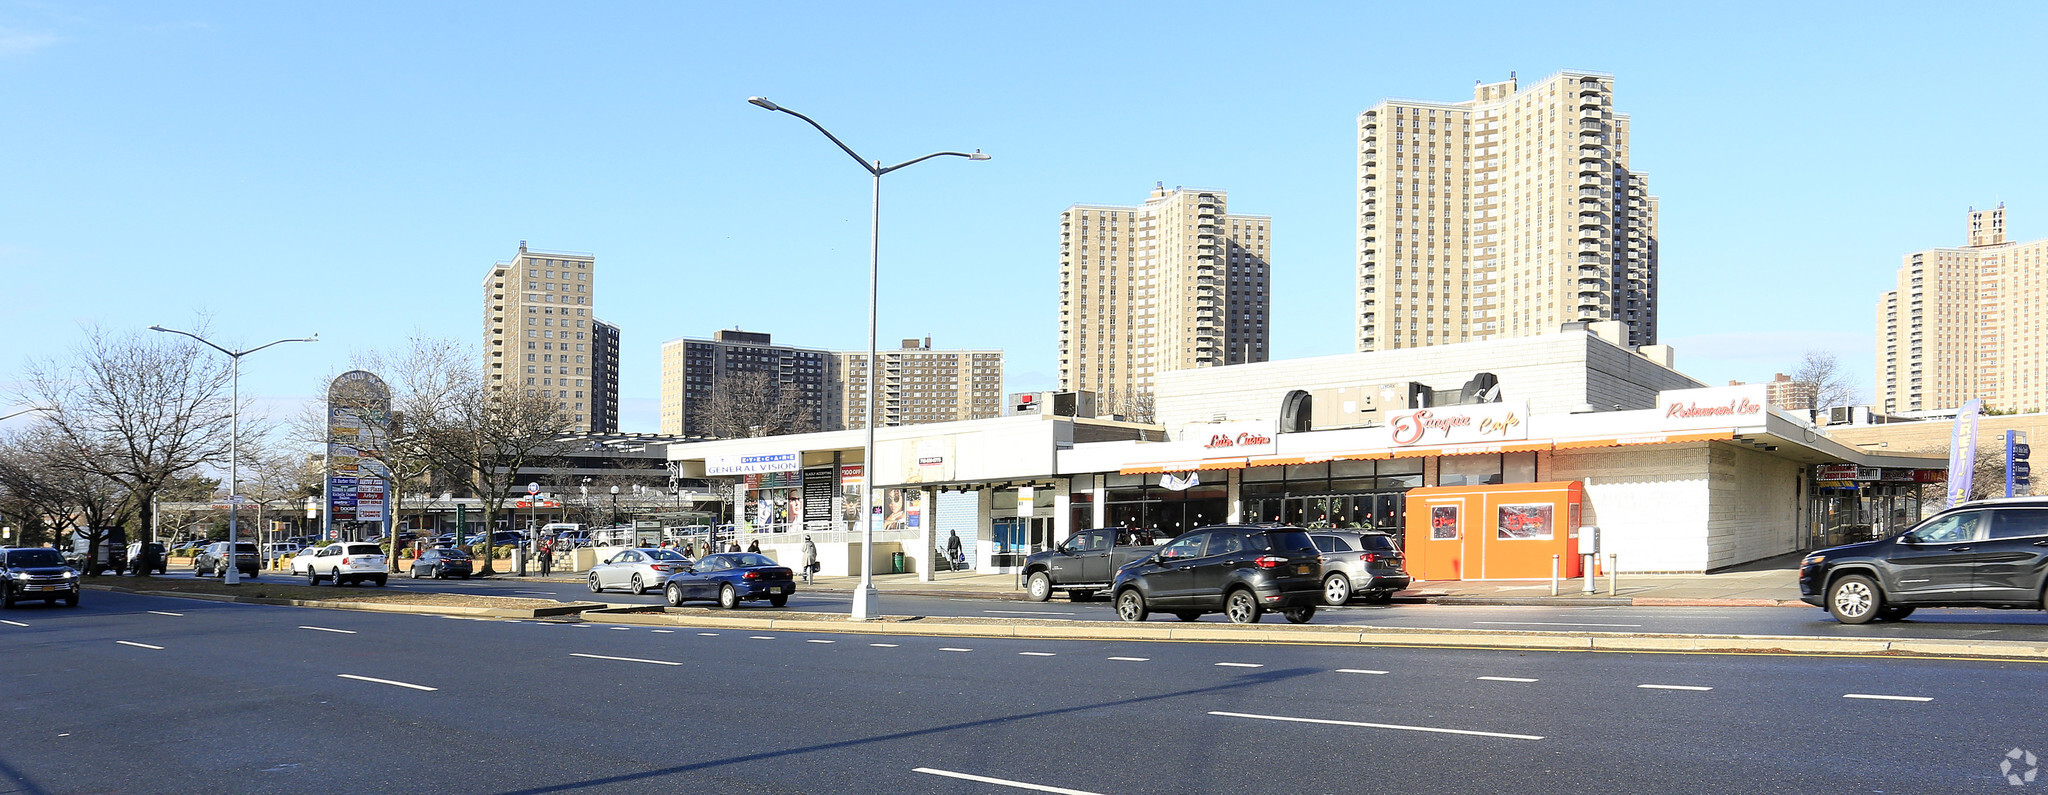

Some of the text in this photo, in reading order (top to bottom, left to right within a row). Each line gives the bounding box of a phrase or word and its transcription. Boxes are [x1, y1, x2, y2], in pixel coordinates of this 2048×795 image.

[1666, 397, 1760, 419] Restaurant Bar
[1391, 409, 1520, 445] Sangria Cafe
[1204, 432, 1270, 449] Latin Cuisine
[708, 462, 797, 475] GENERAL VISION
